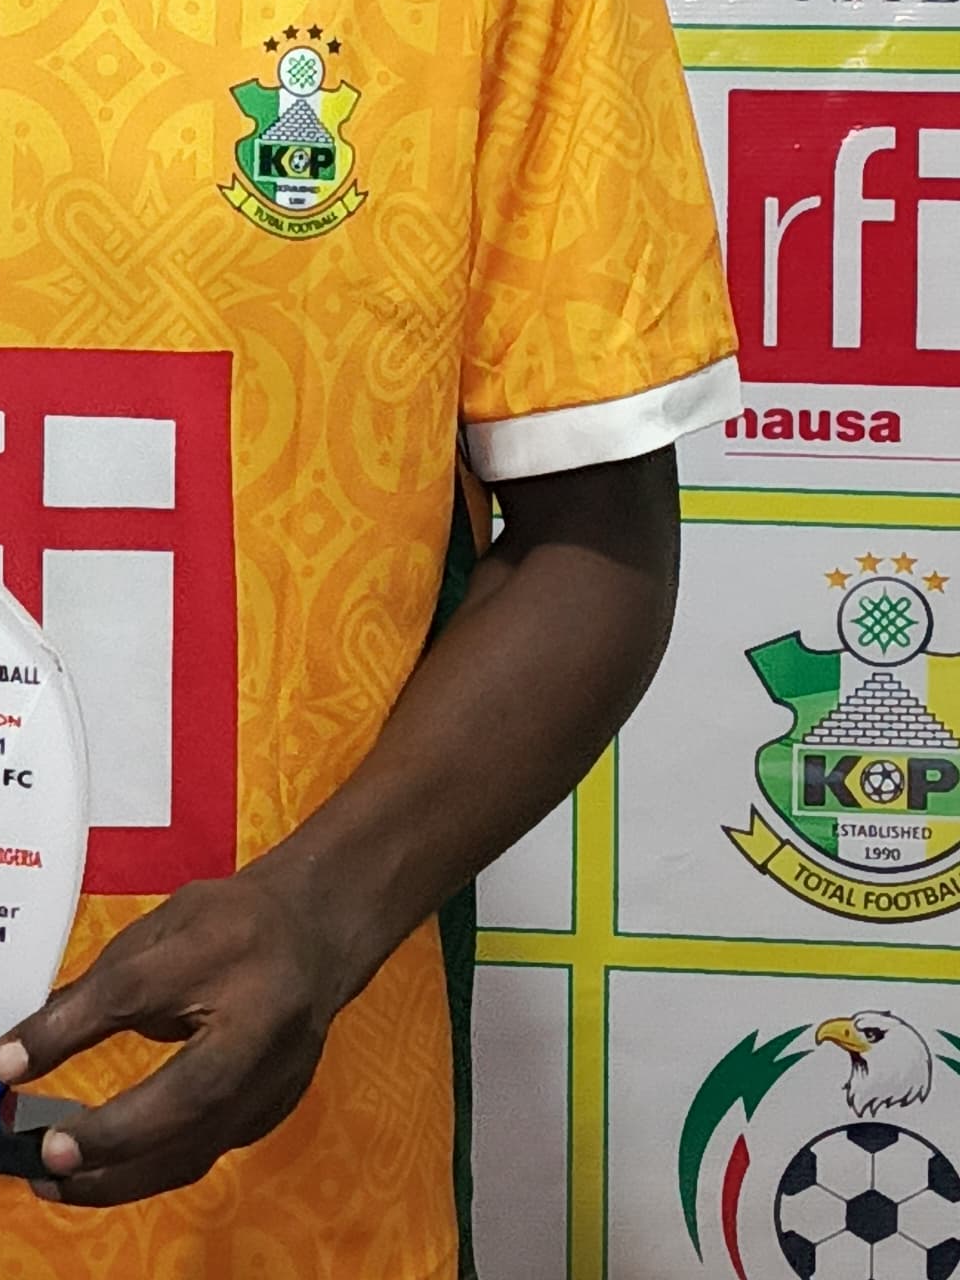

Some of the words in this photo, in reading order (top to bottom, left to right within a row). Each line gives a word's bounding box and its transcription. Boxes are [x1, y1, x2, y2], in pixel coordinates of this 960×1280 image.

[3, 769, 33, 789] FC
[832, 822, 933, 840] ESTABLISHED
[864, 845, 901, 861] 1990
[793, 862, 856, 908] TOTAL
[863, 874, 960, 912] FOOTBAL
